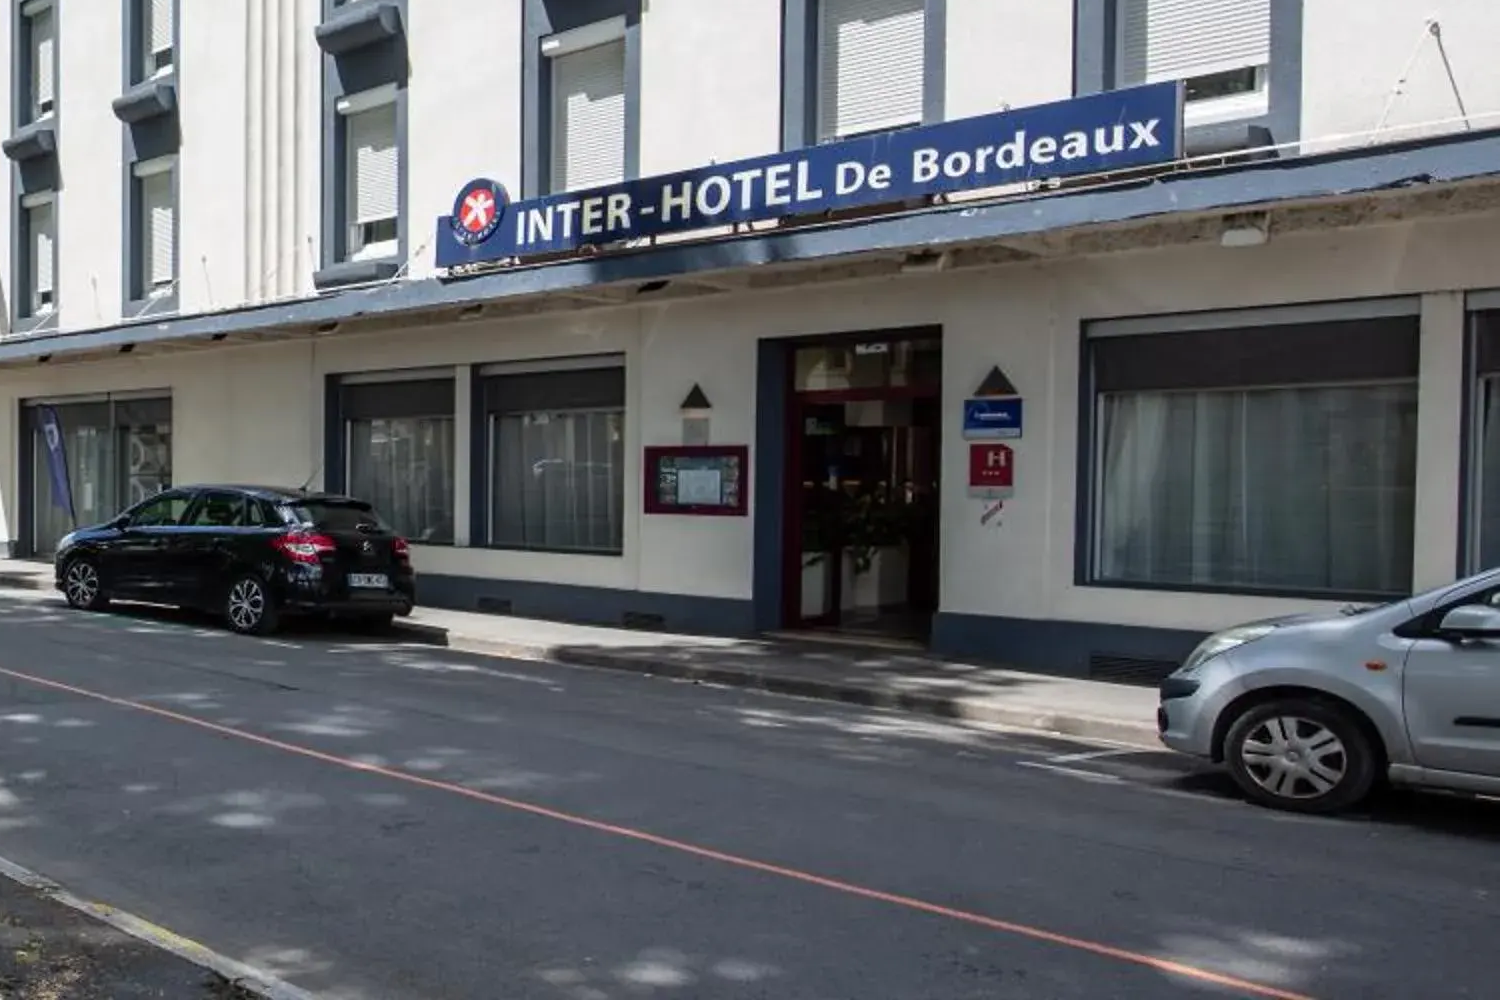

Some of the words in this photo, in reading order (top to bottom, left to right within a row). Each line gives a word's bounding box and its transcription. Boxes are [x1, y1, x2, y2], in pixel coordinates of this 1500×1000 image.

[835, 161, 892, 195] De
[912, 118, 1162, 184] Bordeaux
[987, 451, 1006, 467] H
